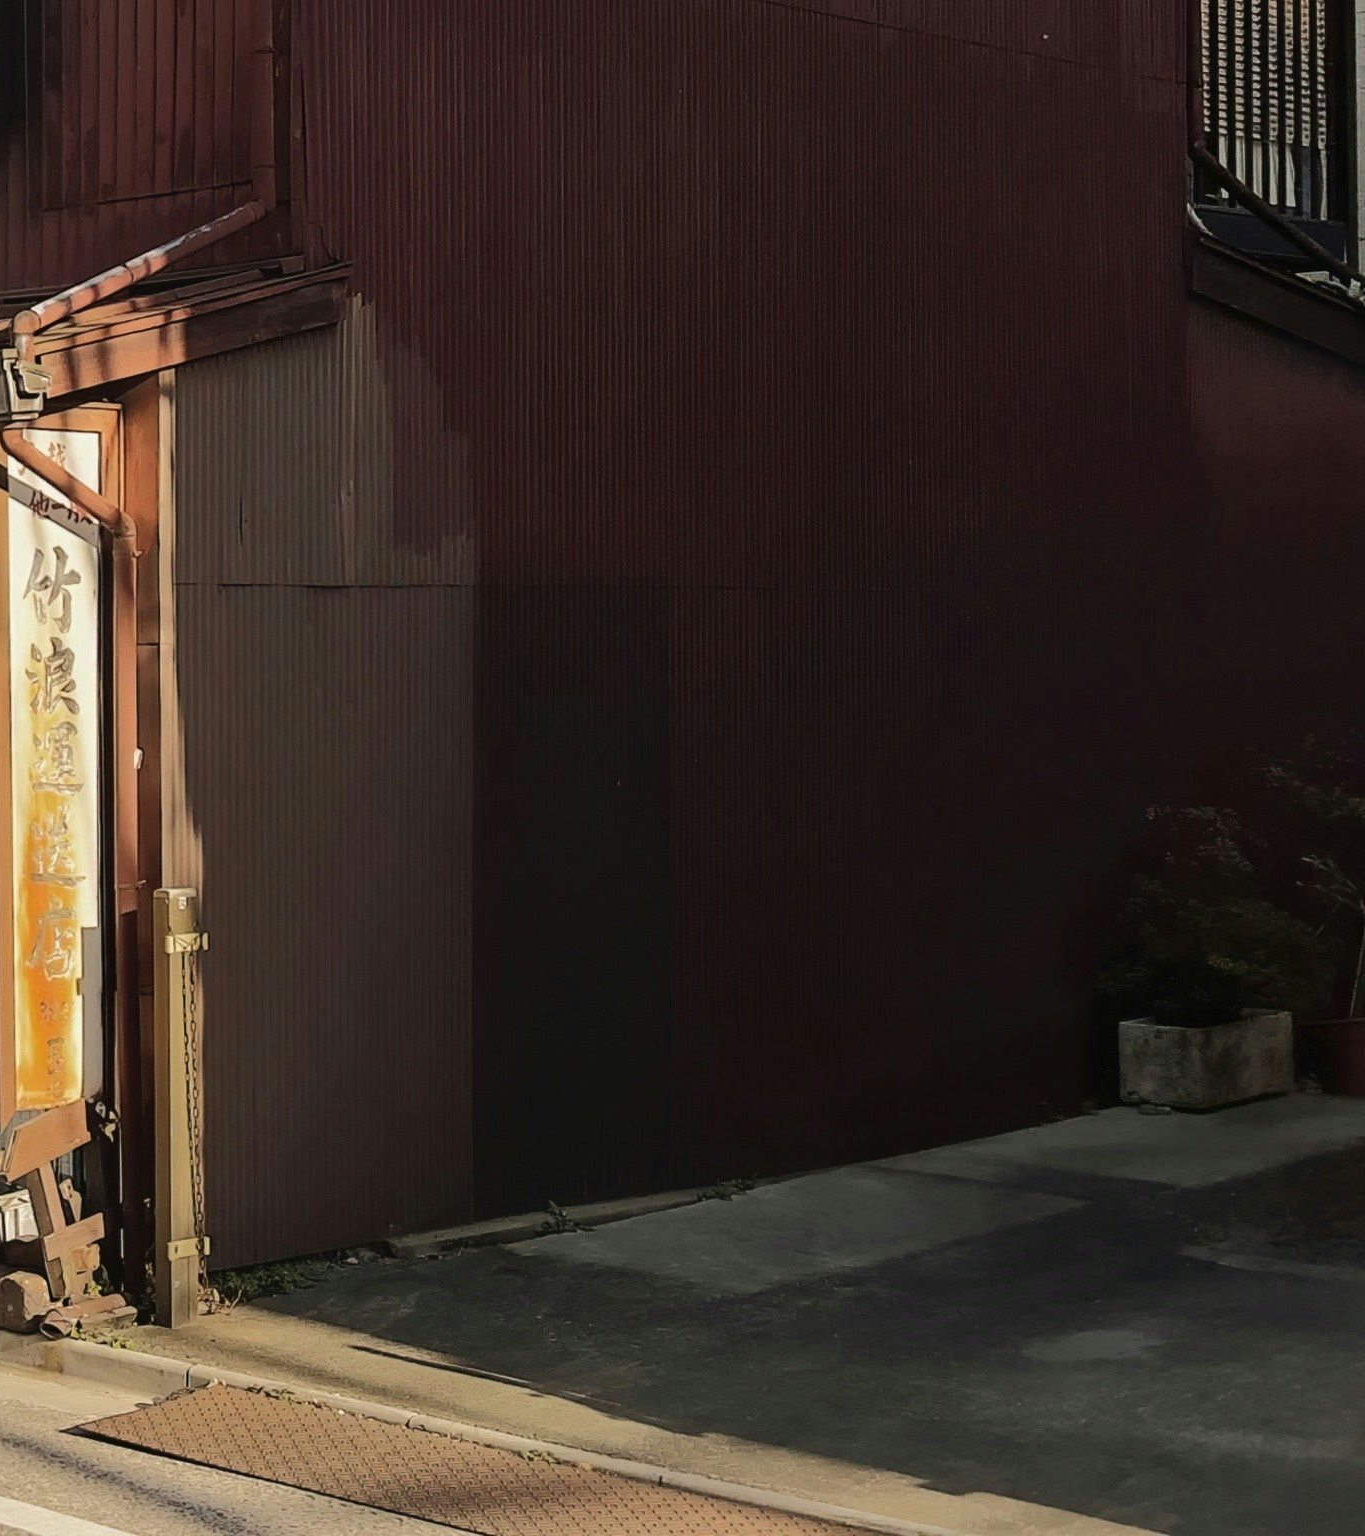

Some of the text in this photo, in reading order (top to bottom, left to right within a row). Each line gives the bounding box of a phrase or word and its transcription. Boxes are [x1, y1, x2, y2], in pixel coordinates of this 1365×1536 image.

[23, 545, 86, 981] 竹浪運送店
